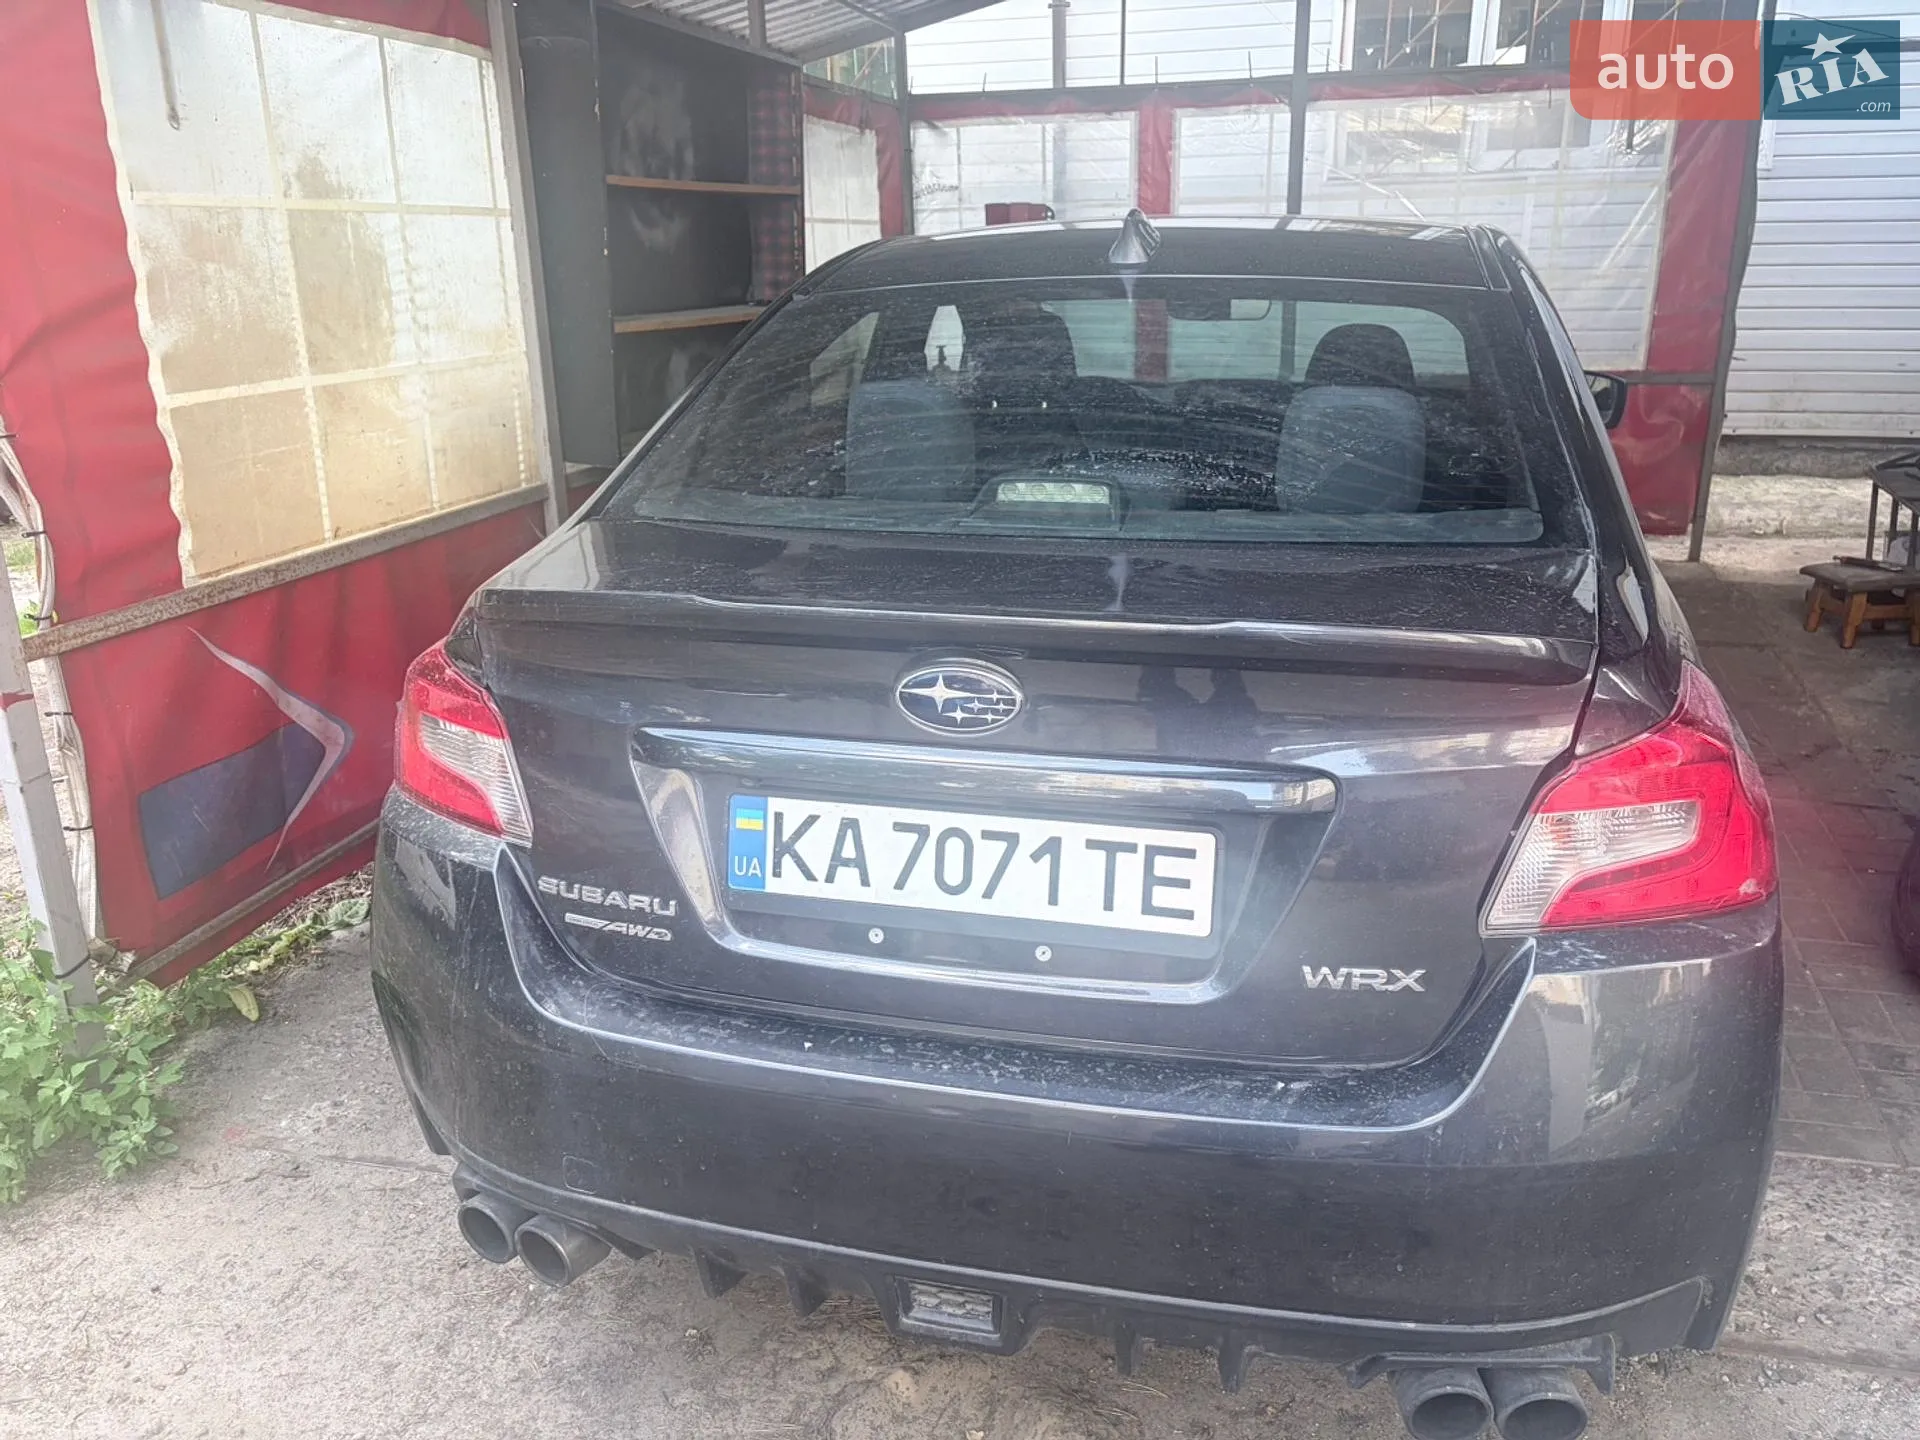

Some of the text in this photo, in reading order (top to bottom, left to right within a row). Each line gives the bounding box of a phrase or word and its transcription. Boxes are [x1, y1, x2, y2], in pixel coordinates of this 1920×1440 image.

[734, 855, 762, 878] UA
[772, 811, 1197, 921] KA 7071 TE
[537, 875, 678, 917] SUBARU
[602, 921, 673, 941] AWD
[1301, 965, 1427, 992] WRX
